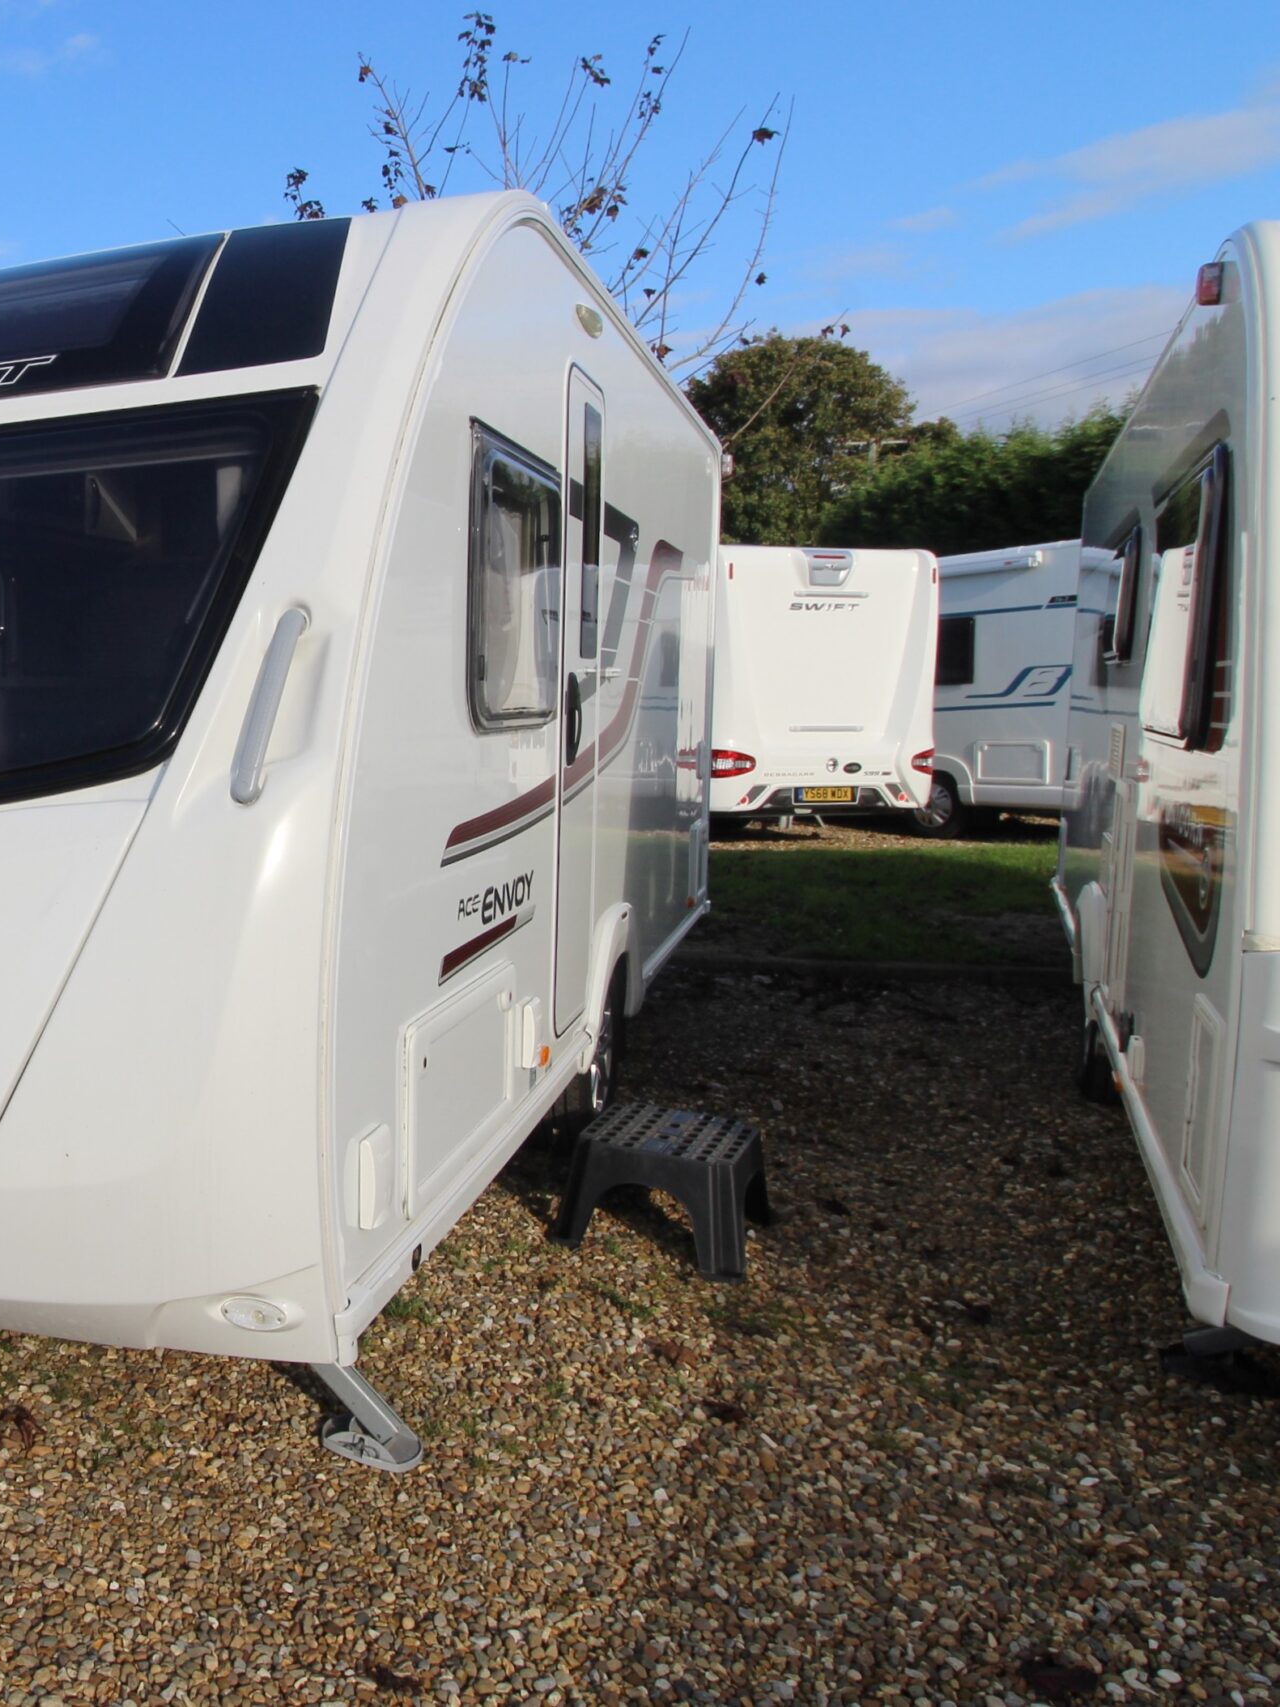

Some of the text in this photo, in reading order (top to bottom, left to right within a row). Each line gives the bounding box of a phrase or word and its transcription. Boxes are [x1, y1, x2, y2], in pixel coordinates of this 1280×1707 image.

[789, 602, 860, 612] SWIFT
[804, 787, 828, 799] YS68
[457, 869, 534, 925] ACE ENVOY
